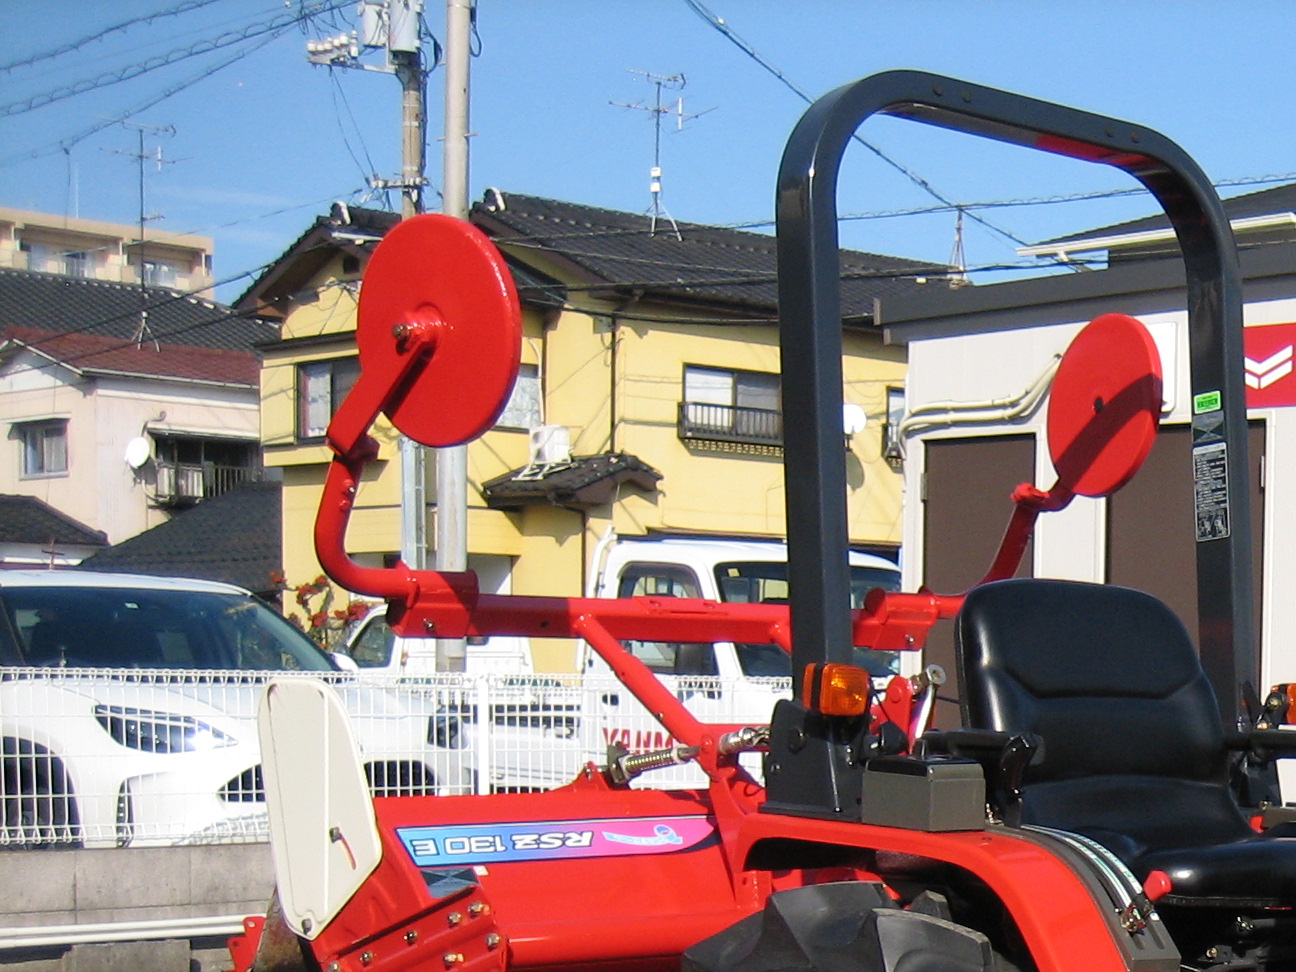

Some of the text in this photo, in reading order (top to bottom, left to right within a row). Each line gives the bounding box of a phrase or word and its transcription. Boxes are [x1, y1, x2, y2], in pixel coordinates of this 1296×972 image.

[601, 727, 674, 756] YANM
[409, 838, 440, 857] E
[443, 835, 507, 855] 130
